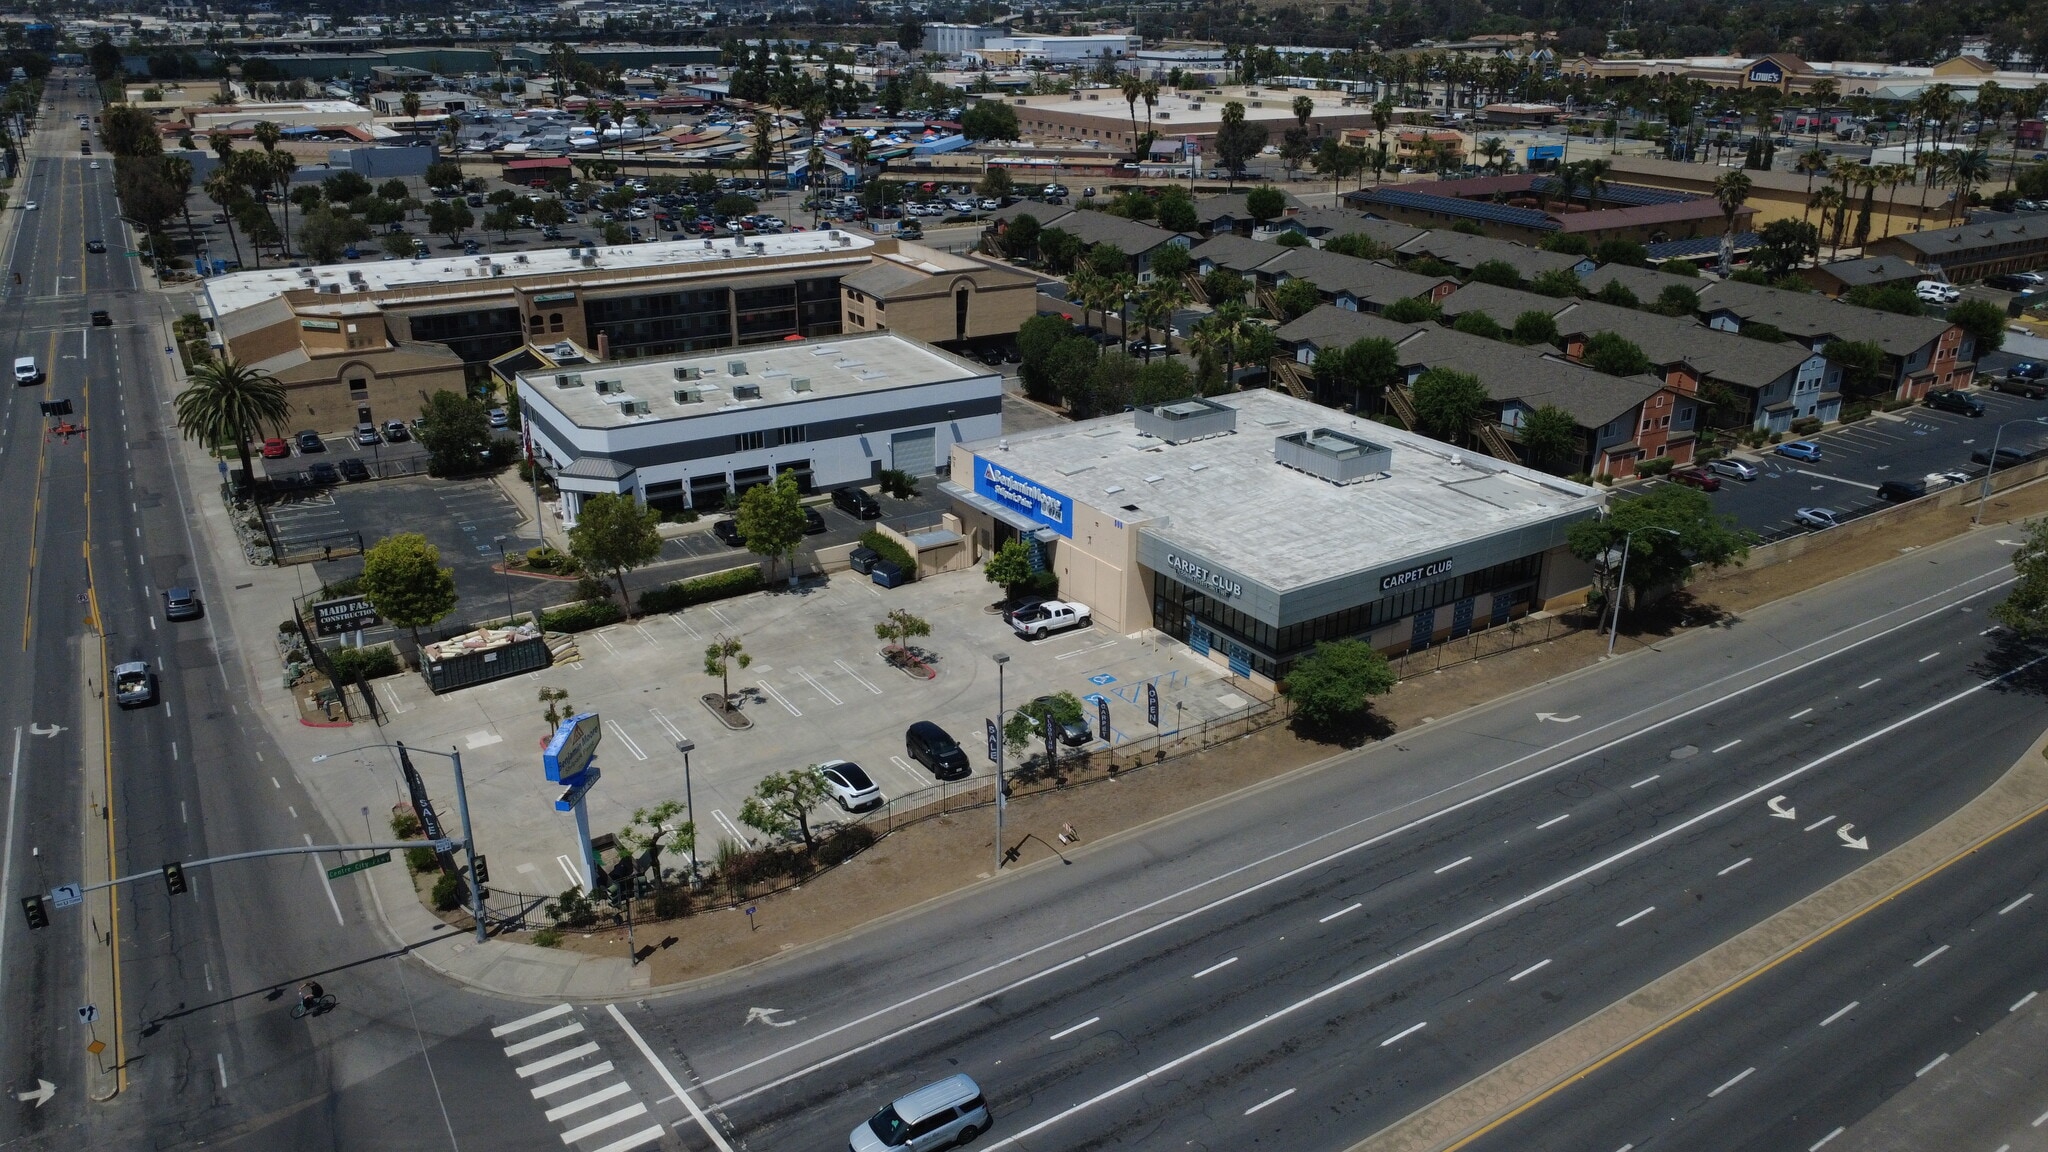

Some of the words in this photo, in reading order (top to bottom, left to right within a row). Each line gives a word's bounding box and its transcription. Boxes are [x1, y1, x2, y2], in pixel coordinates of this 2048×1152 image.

[1750, 71, 1779, 83] LOWE'S
[1167, 553, 1209, 582] CARPET
[1212, 574, 1242, 596] CLUB
[1383, 567, 1423, 590] CARPET
[1425, 559, 1453, 577] CLUB
[319, 605, 348, 618] MAID
[349, 601, 375, 611] FAST
[320, 608, 377, 624] CONSTRUCTION
[1149, 689, 1157, 723] OPEN
[988, 725, 997, 760] SALE
[419, 799, 437, 835] SALE
[329, 865, 351, 878] Centre
[355, 858, 369, 870] City
